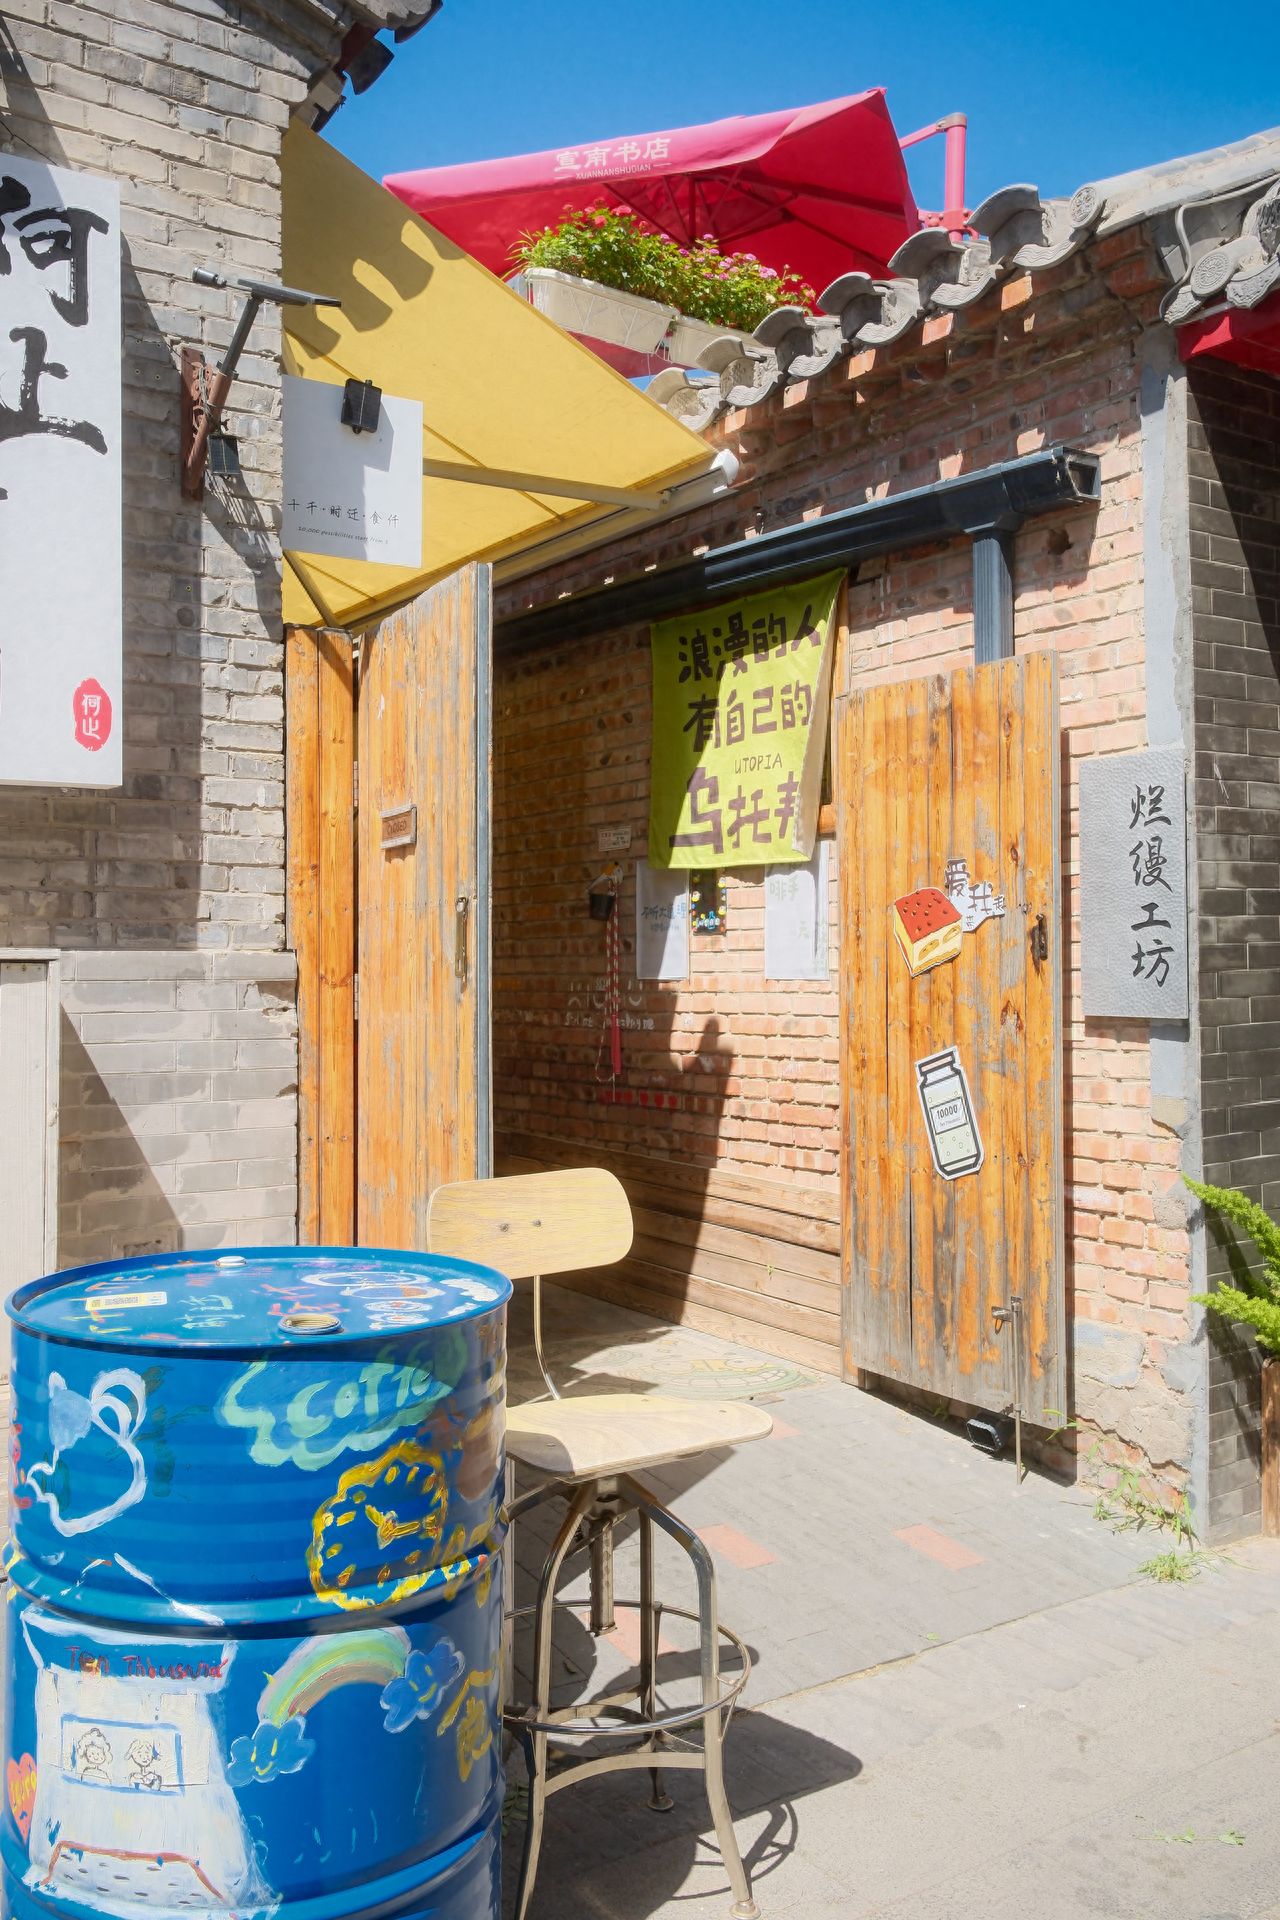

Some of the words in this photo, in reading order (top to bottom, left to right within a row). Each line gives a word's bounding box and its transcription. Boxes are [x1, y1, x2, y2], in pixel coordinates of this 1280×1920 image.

[553, 137, 672, 172] 宣南书店
[575, 163, 652, 180] XUANNANSHUDIAN
[677, 603, 823, 684] 浪漫的人
[682, 679, 813, 754] 有自己的
[734, 752, 783, 774] UTOPIA
[936, 1103, 958, 1119] 10000
[66, 1645, 110, 1674] Ten
